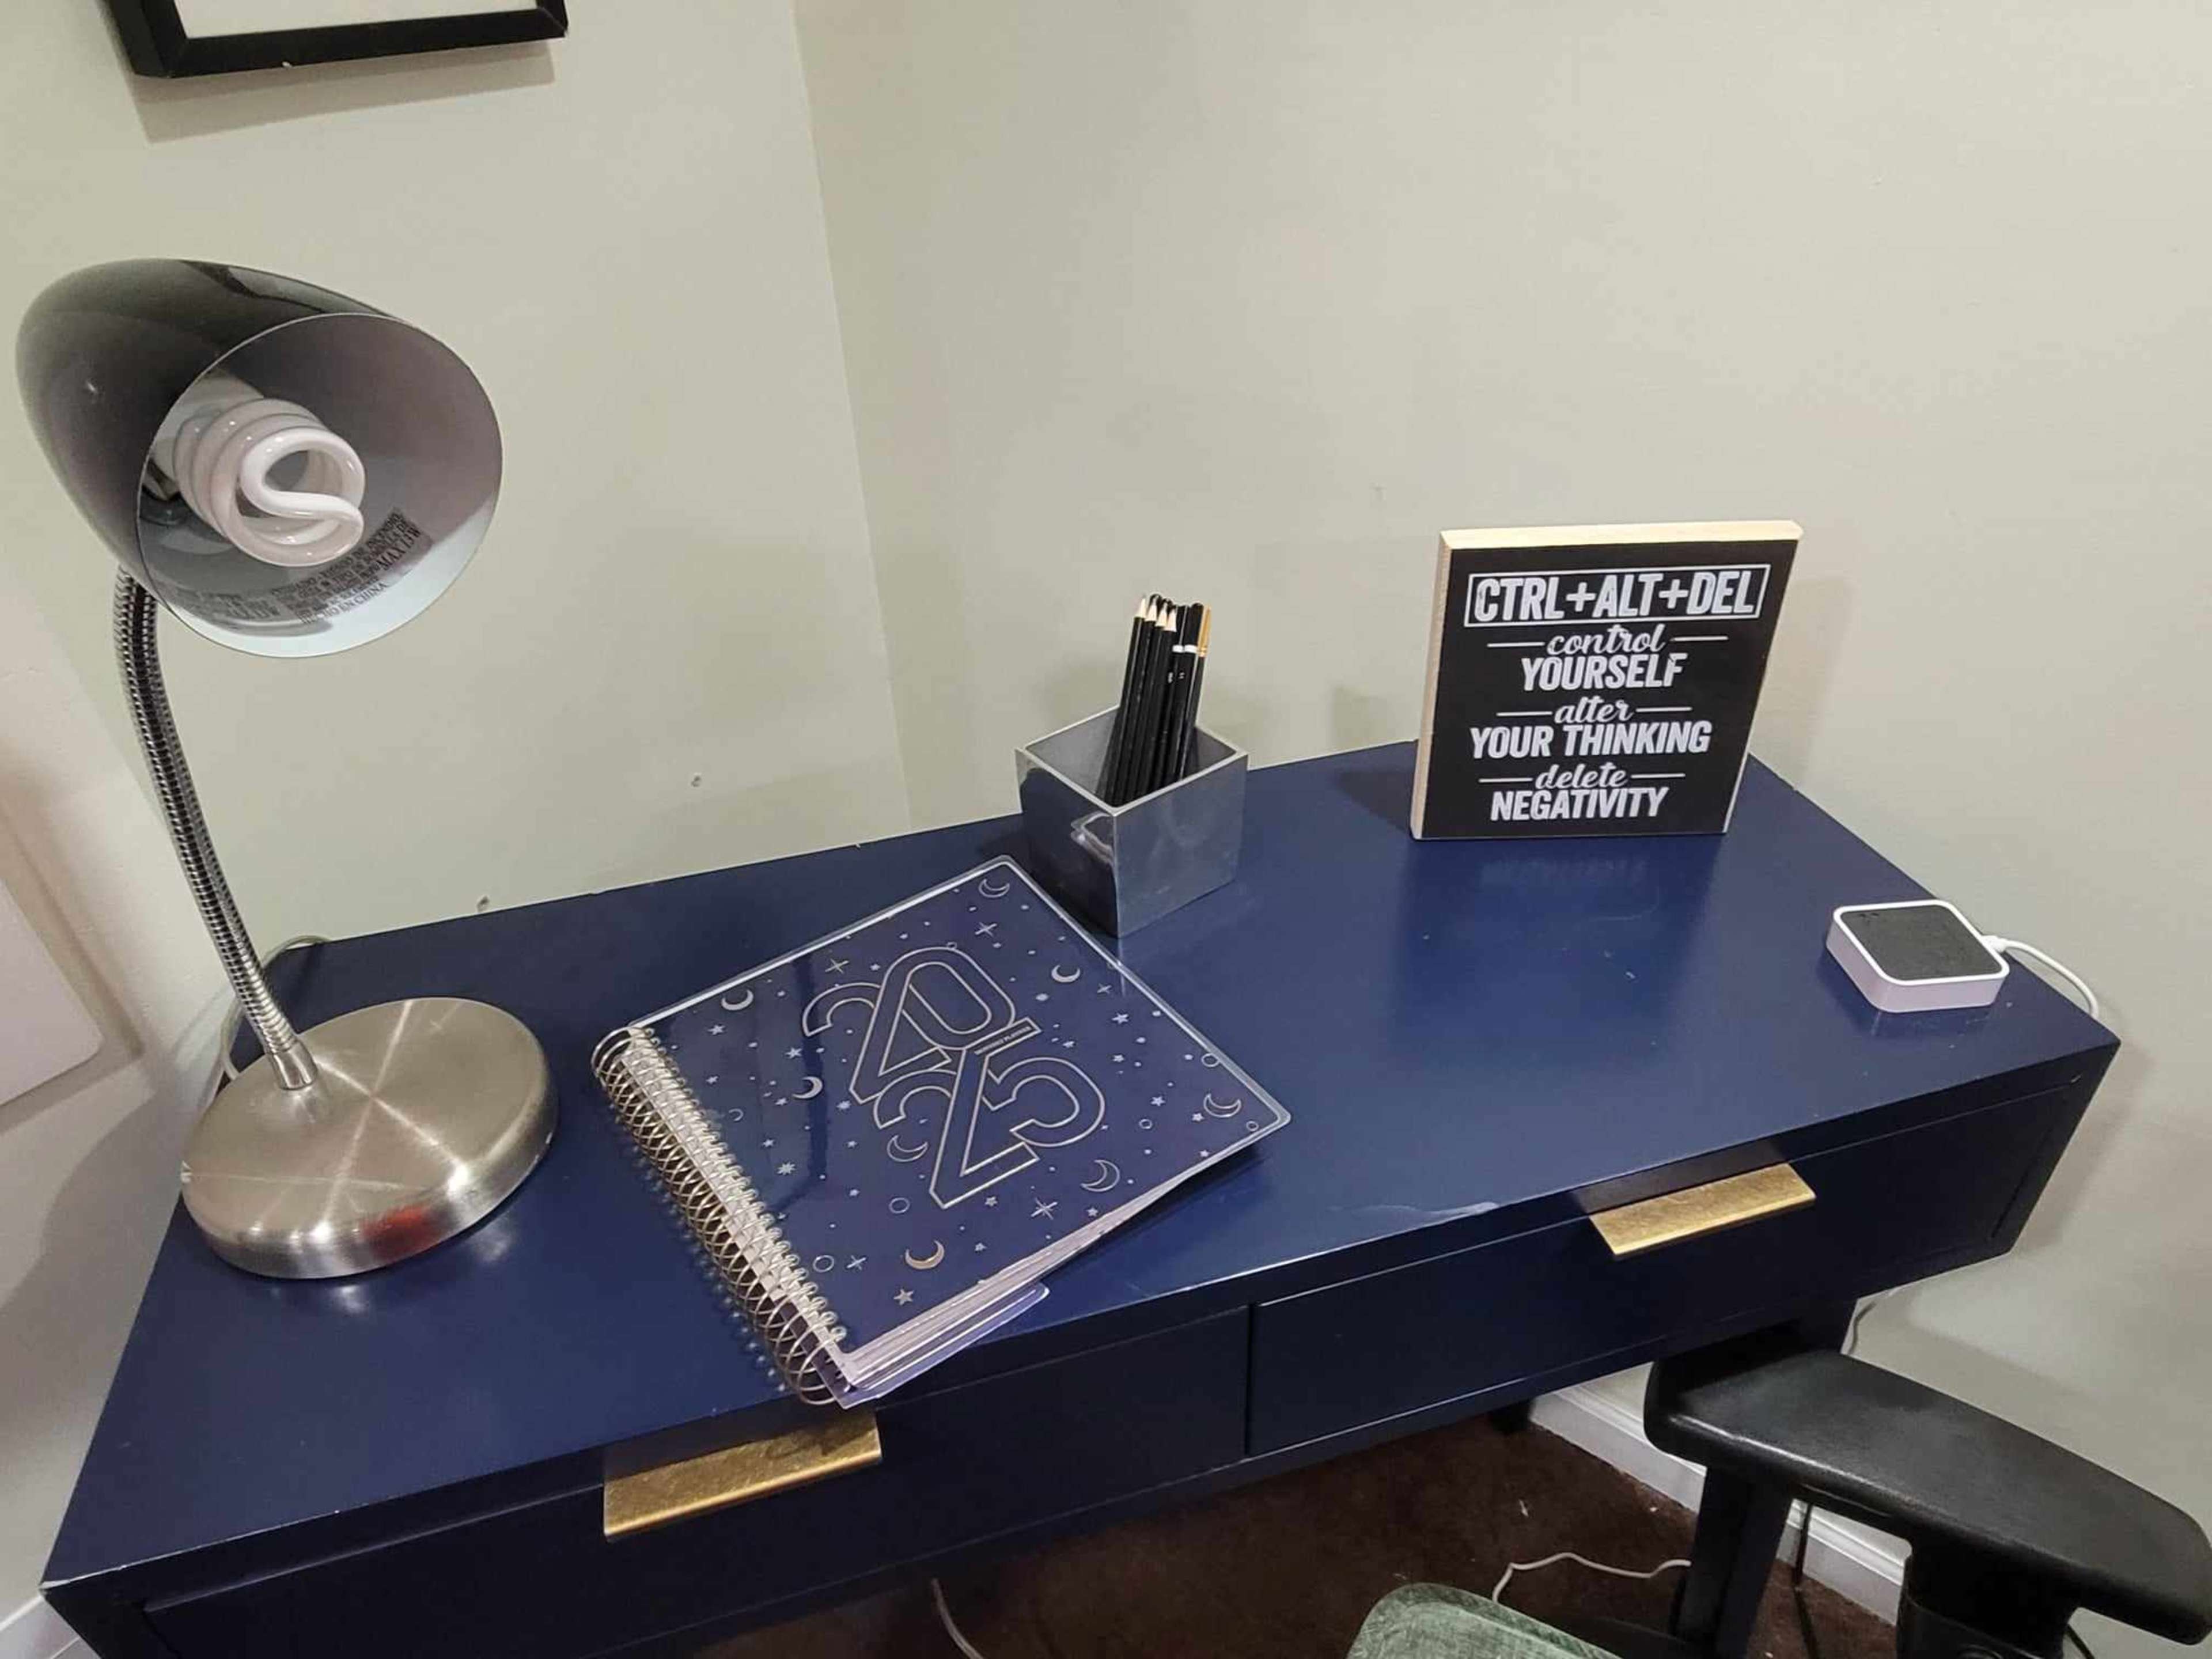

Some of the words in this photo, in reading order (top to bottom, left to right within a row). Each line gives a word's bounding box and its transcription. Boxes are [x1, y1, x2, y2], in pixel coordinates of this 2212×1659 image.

[1474, 570, 1755, 622] CTRL+ALT+DEL
[1546, 623, 1665, 656] control
[1521, 653, 1688, 691] YOURSELF
[1554, 695, 1634, 724] alter
[1470, 725, 1554, 759] YOUR
[1562, 720, 1712, 756] THINKING
[1535, 762, 1629, 790] delete
[1490, 786, 1669, 821] NEGATIVITY
